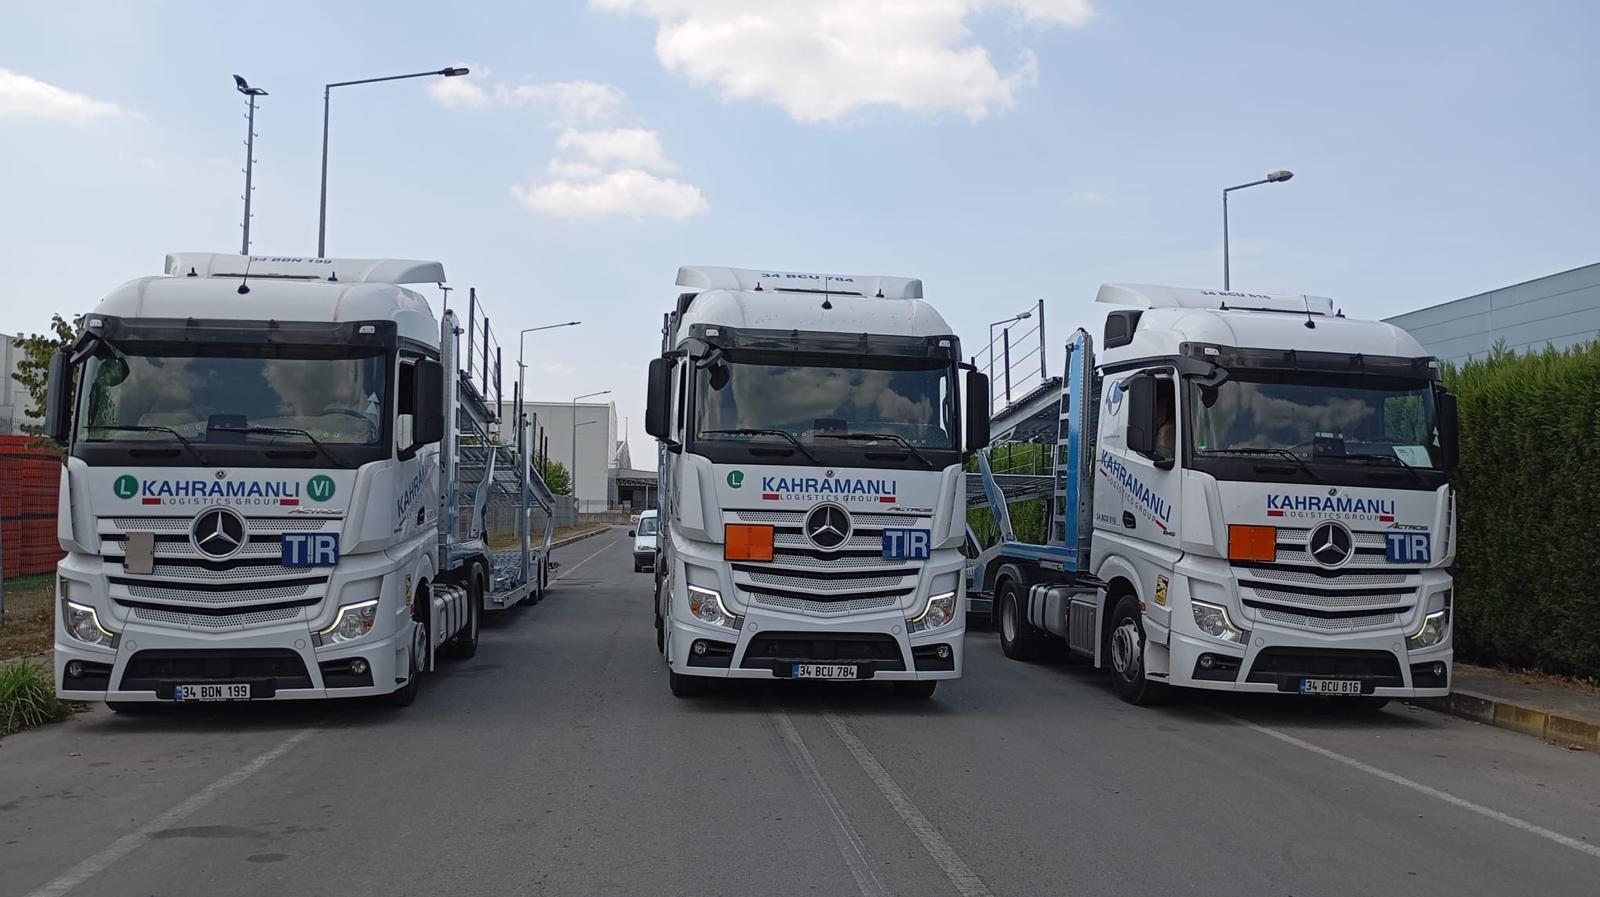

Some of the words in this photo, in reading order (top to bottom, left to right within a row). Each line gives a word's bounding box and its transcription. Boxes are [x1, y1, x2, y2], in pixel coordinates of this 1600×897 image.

[142, 480, 299, 497] KAHRAMANLI
[312, 480, 330, 497] VI
[762, 477, 896, 495] KAHRAMANLI
[1100, 449, 1172, 522] KAHRAMANLI
[780, 494, 843, 502] LOGISTICS
[843, 495, 880, 503] GROUP
[1267, 494, 1395, 515] KAHRAMANLI
[1284, 511, 1341, 519] LOGISTICS
[1345, 513, 1380, 521] GROUP
[286, 535, 336, 564] TIR
[886, 531, 929, 558] TIR
[1389, 534, 1429, 561] TIR
[800, 666, 811, 676] 34
[815, 666, 833, 677] BCU
[837, 667, 854, 677] 784
[183, 686, 196, 697] 34
[201, 686, 222, 697] BDN
[227, 685, 247, 697] 199
[1306, 681, 1317, 691] 34
[1321, 681, 1339, 692] BCU
[1341, 682, 1359, 692] 816
